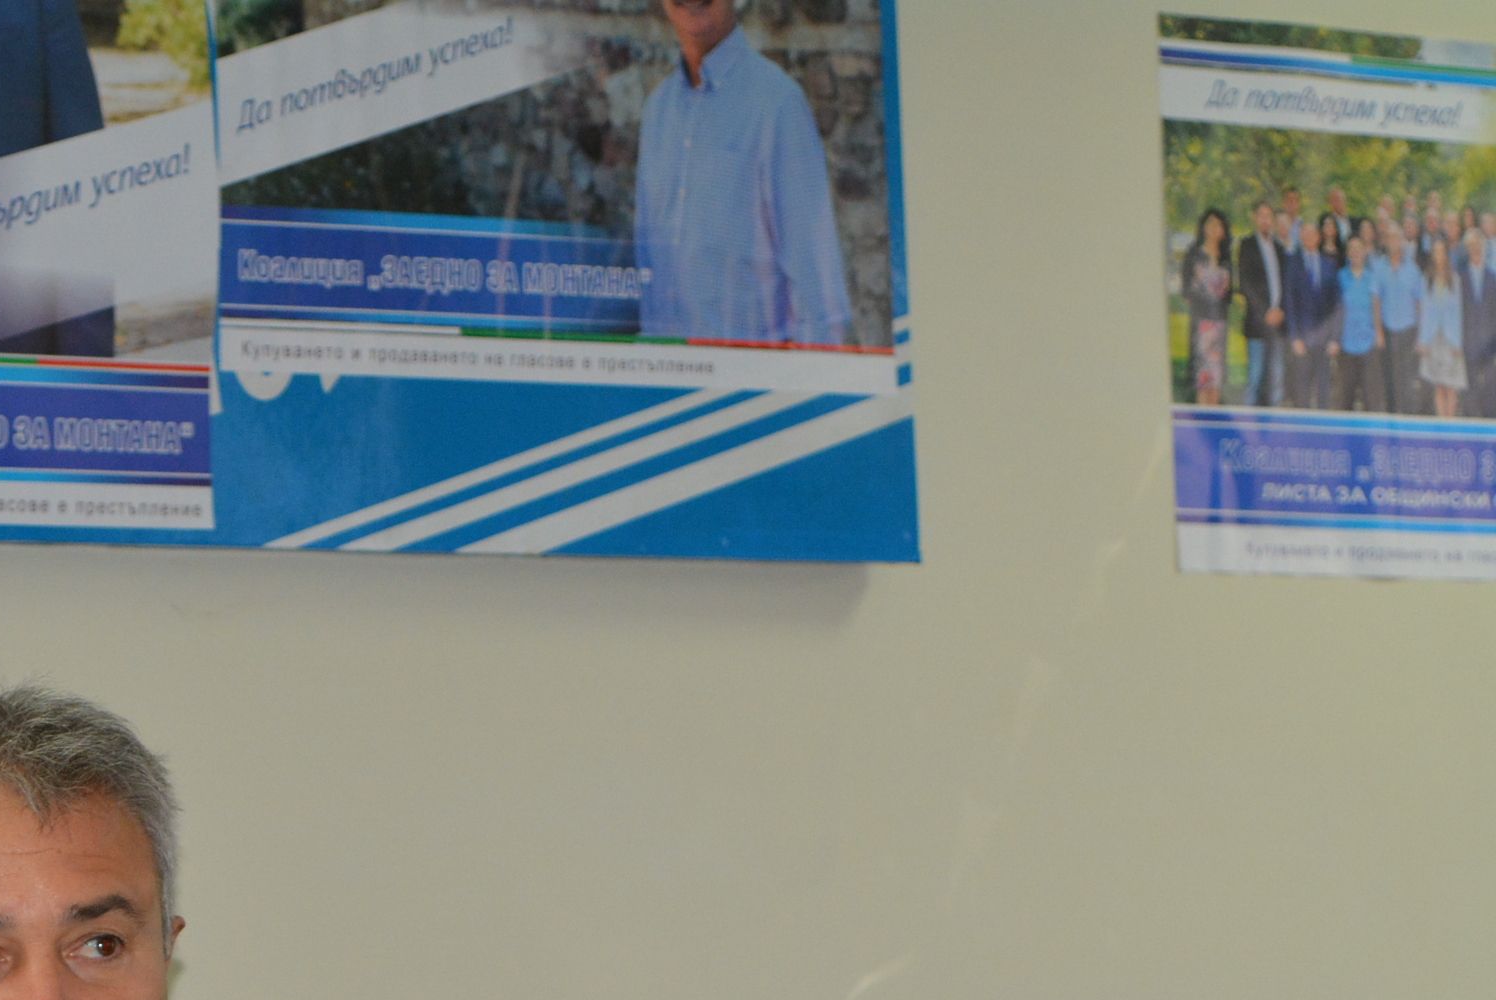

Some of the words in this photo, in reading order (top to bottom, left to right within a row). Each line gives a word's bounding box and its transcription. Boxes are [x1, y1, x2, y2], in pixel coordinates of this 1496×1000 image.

[237, 97, 272, 134] Да
[280, 52, 423, 117] потвърдим
[428, 15, 514, 77] успеха!
[1205, 79, 1239, 110] Да
[89, 142, 191, 209] успеха!
[238, 248, 365, 289] Коалиция
[484, 258, 521, 294] ЗА
[12, 415, 51, 450] ЗА
[1478, 448, 1496, 485] З
[1262, 482, 1333, 504] ЛИСТА
[1335, 484, 1369, 505] ЗА
